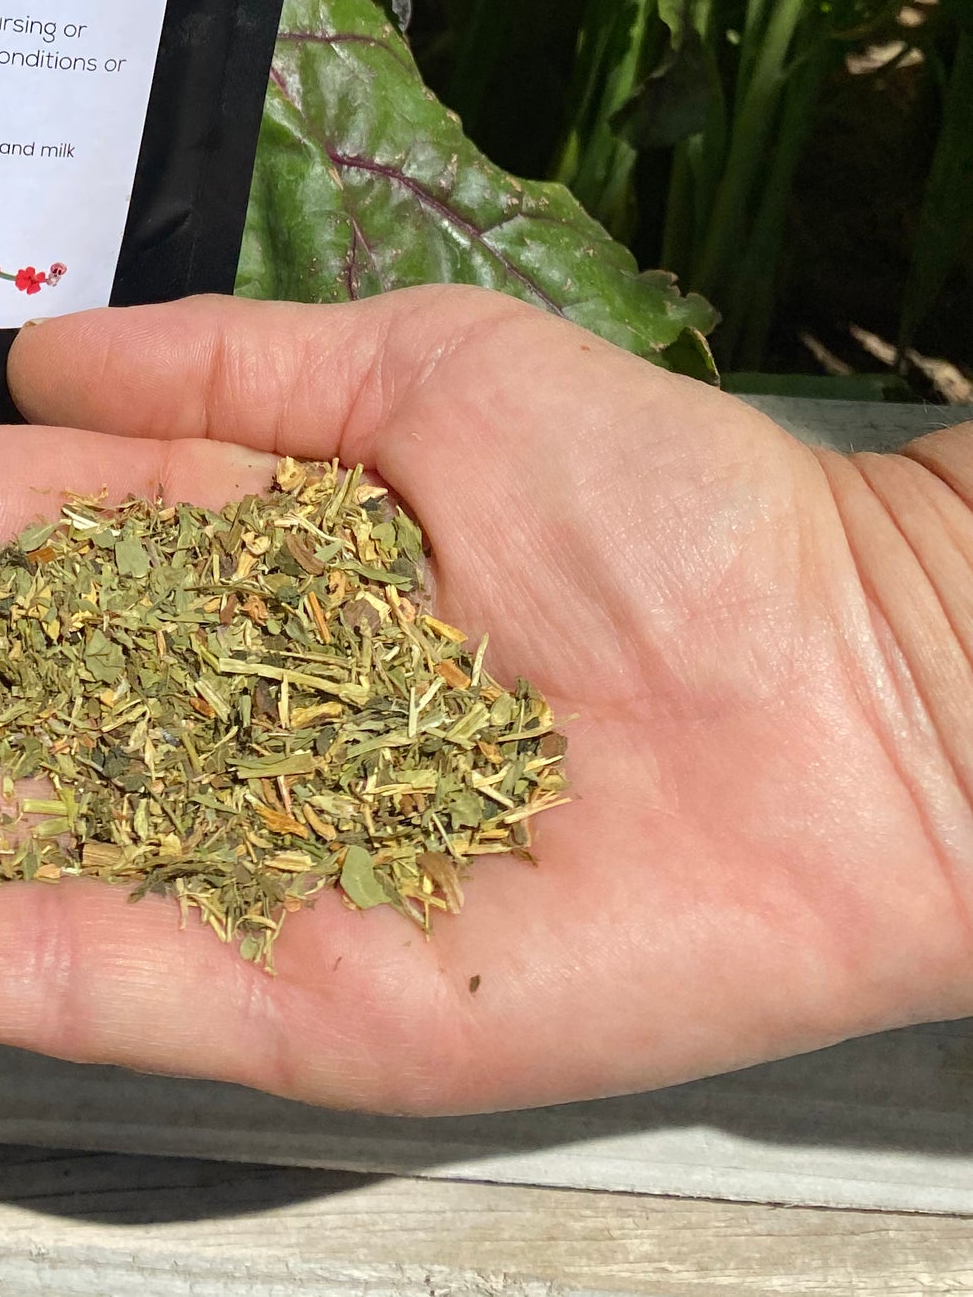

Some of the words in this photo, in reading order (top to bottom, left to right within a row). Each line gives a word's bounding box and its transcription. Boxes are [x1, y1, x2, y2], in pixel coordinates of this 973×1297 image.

[63, 23, 88, 39] or
[104, 58, 127, 73] or
[40, 142, 76, 158] milk
